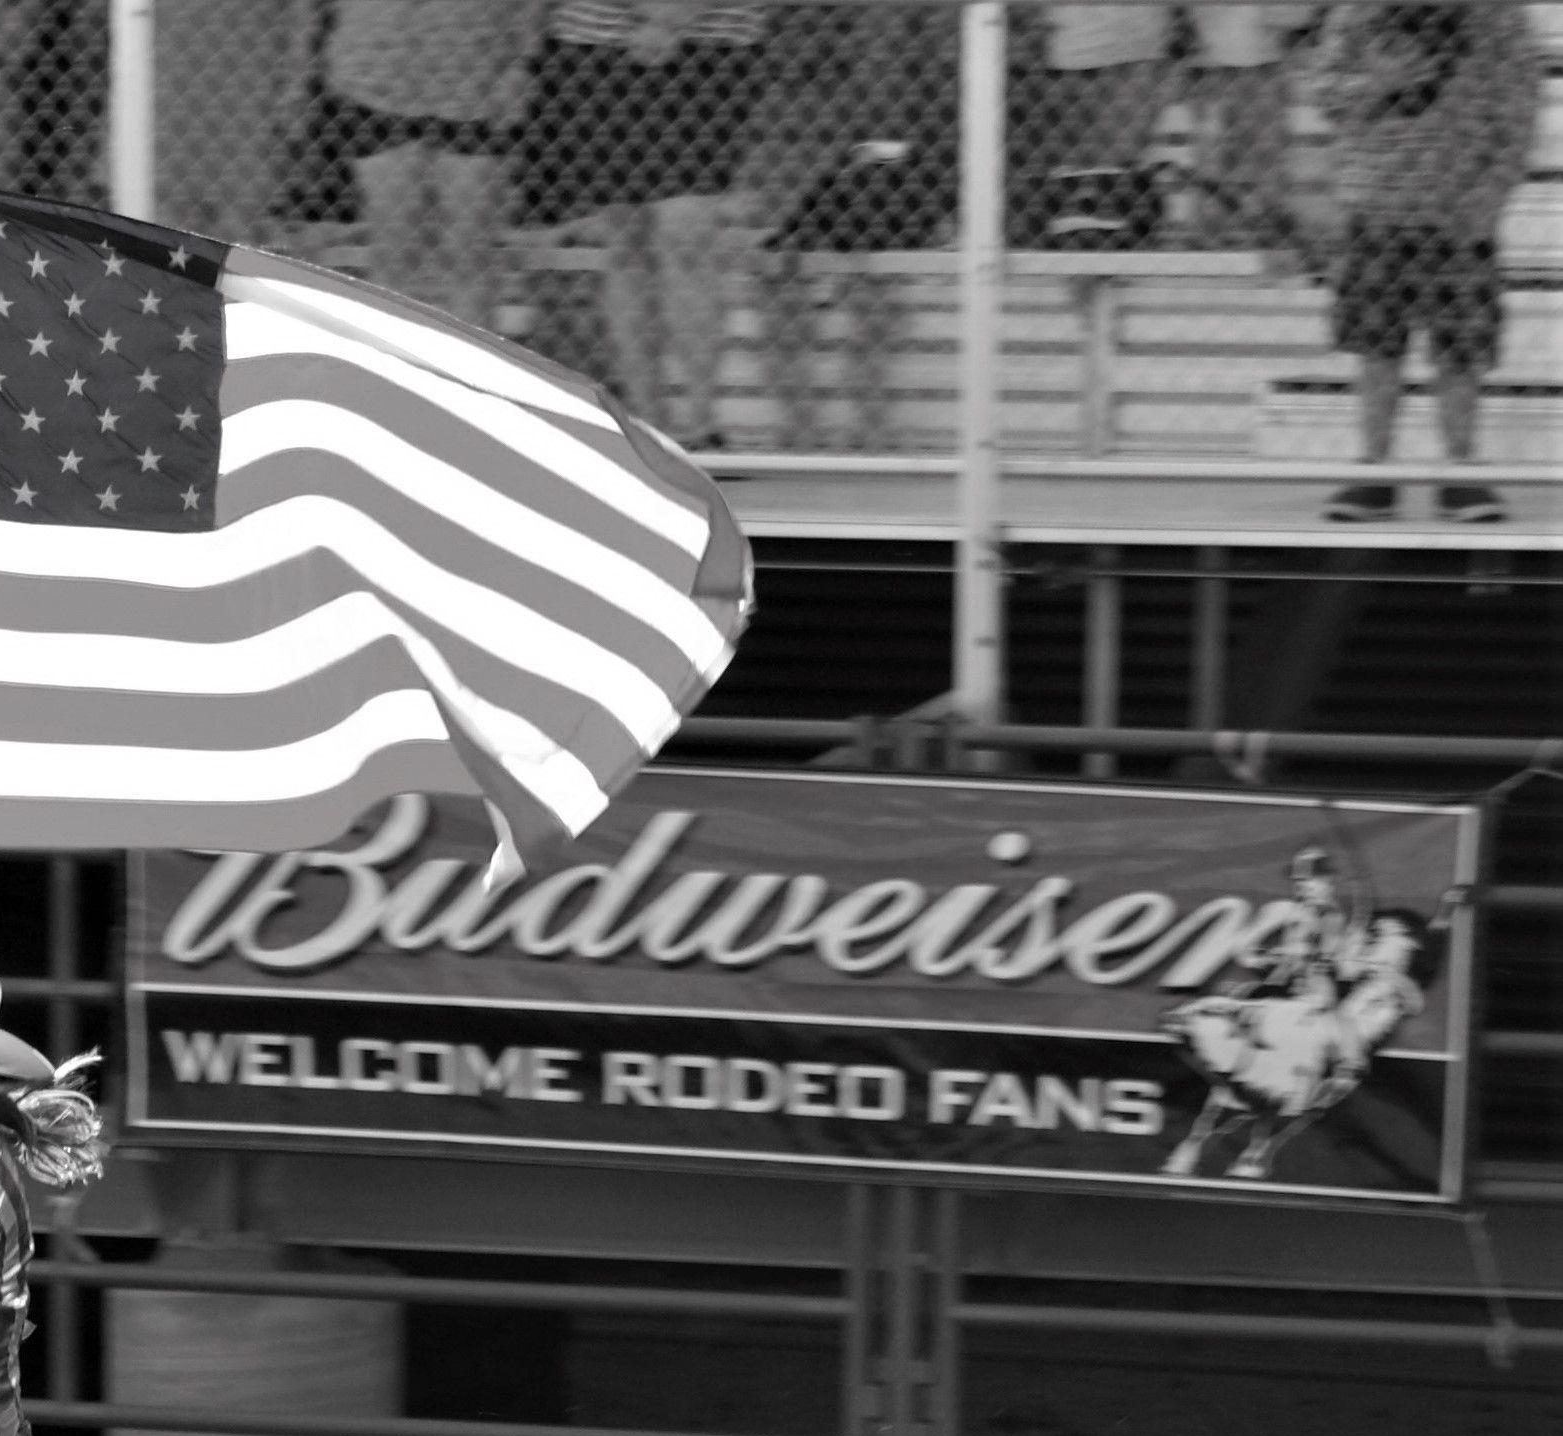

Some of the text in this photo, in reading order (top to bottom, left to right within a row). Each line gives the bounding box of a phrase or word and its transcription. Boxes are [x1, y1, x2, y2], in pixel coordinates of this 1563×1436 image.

[162, 790, 1308, 990] Budweiser
[162, 1030, 1165, 1136] WELCOME RODEO FANS
